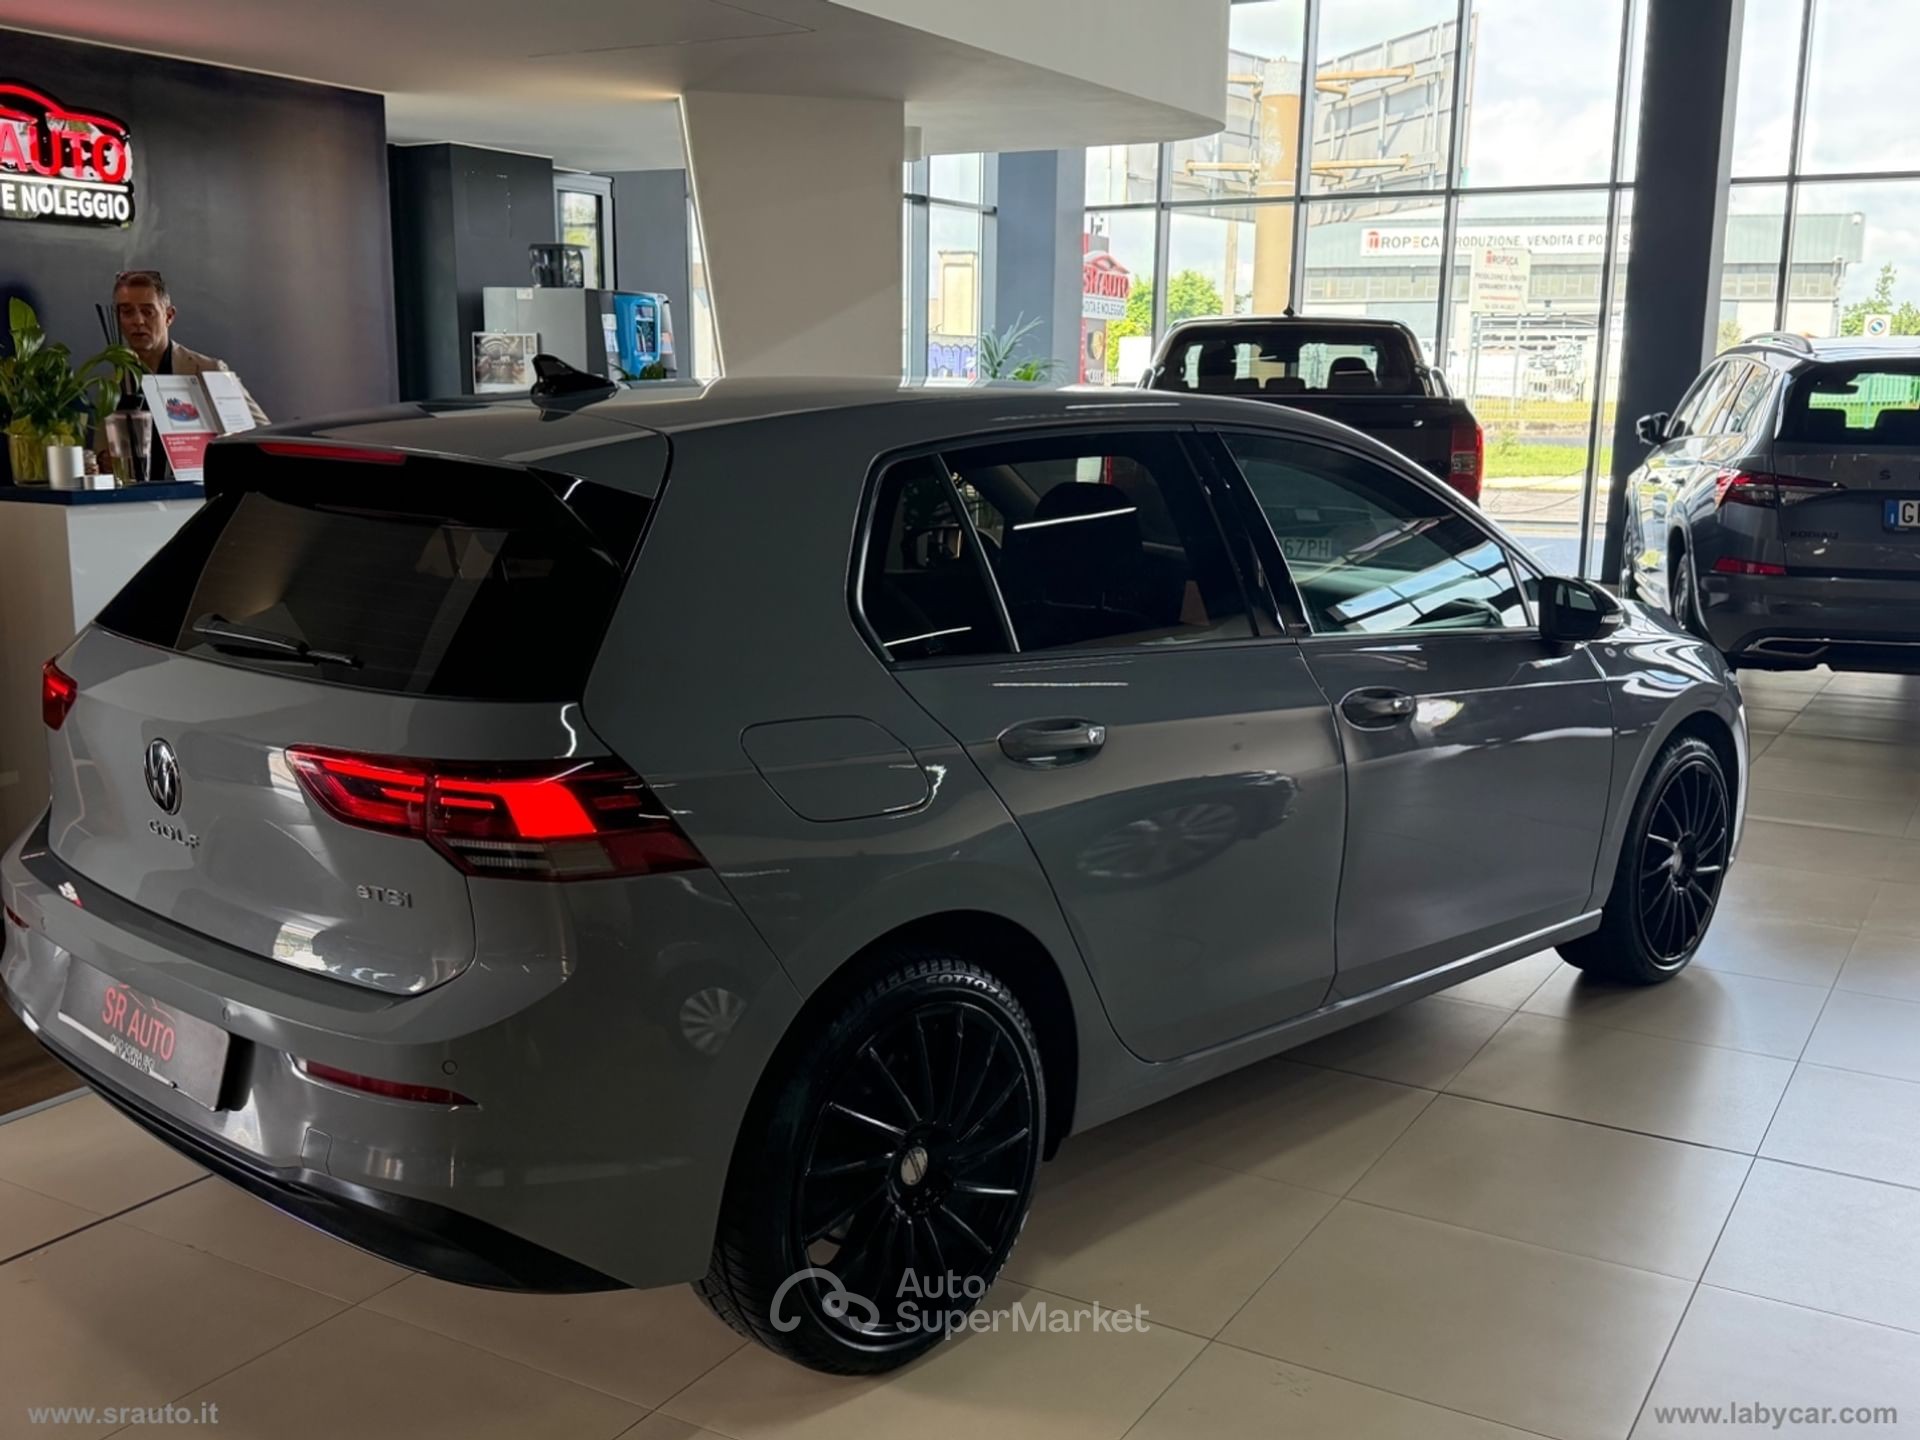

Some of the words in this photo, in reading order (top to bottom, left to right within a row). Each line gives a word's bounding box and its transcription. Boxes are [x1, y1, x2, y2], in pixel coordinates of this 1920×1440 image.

[0, 122, 126, 183] AUTO
[1, 183, 16, 211] E
[22, 186, 129, 221] NOLEGGIO
[1527, 234, 1573, 247] VENDITA
[1577, 233, 1584, 246] E
[1588, 233, 1603, 246] PO
[1902, 502, 1920, 524] G
[1279, 539, 1329, 558] 67PH
[149, 819, 200, 849] GOLF
[102, 986, 127, 1032] SR
[127, 1009, 176, 1061] AUTO
